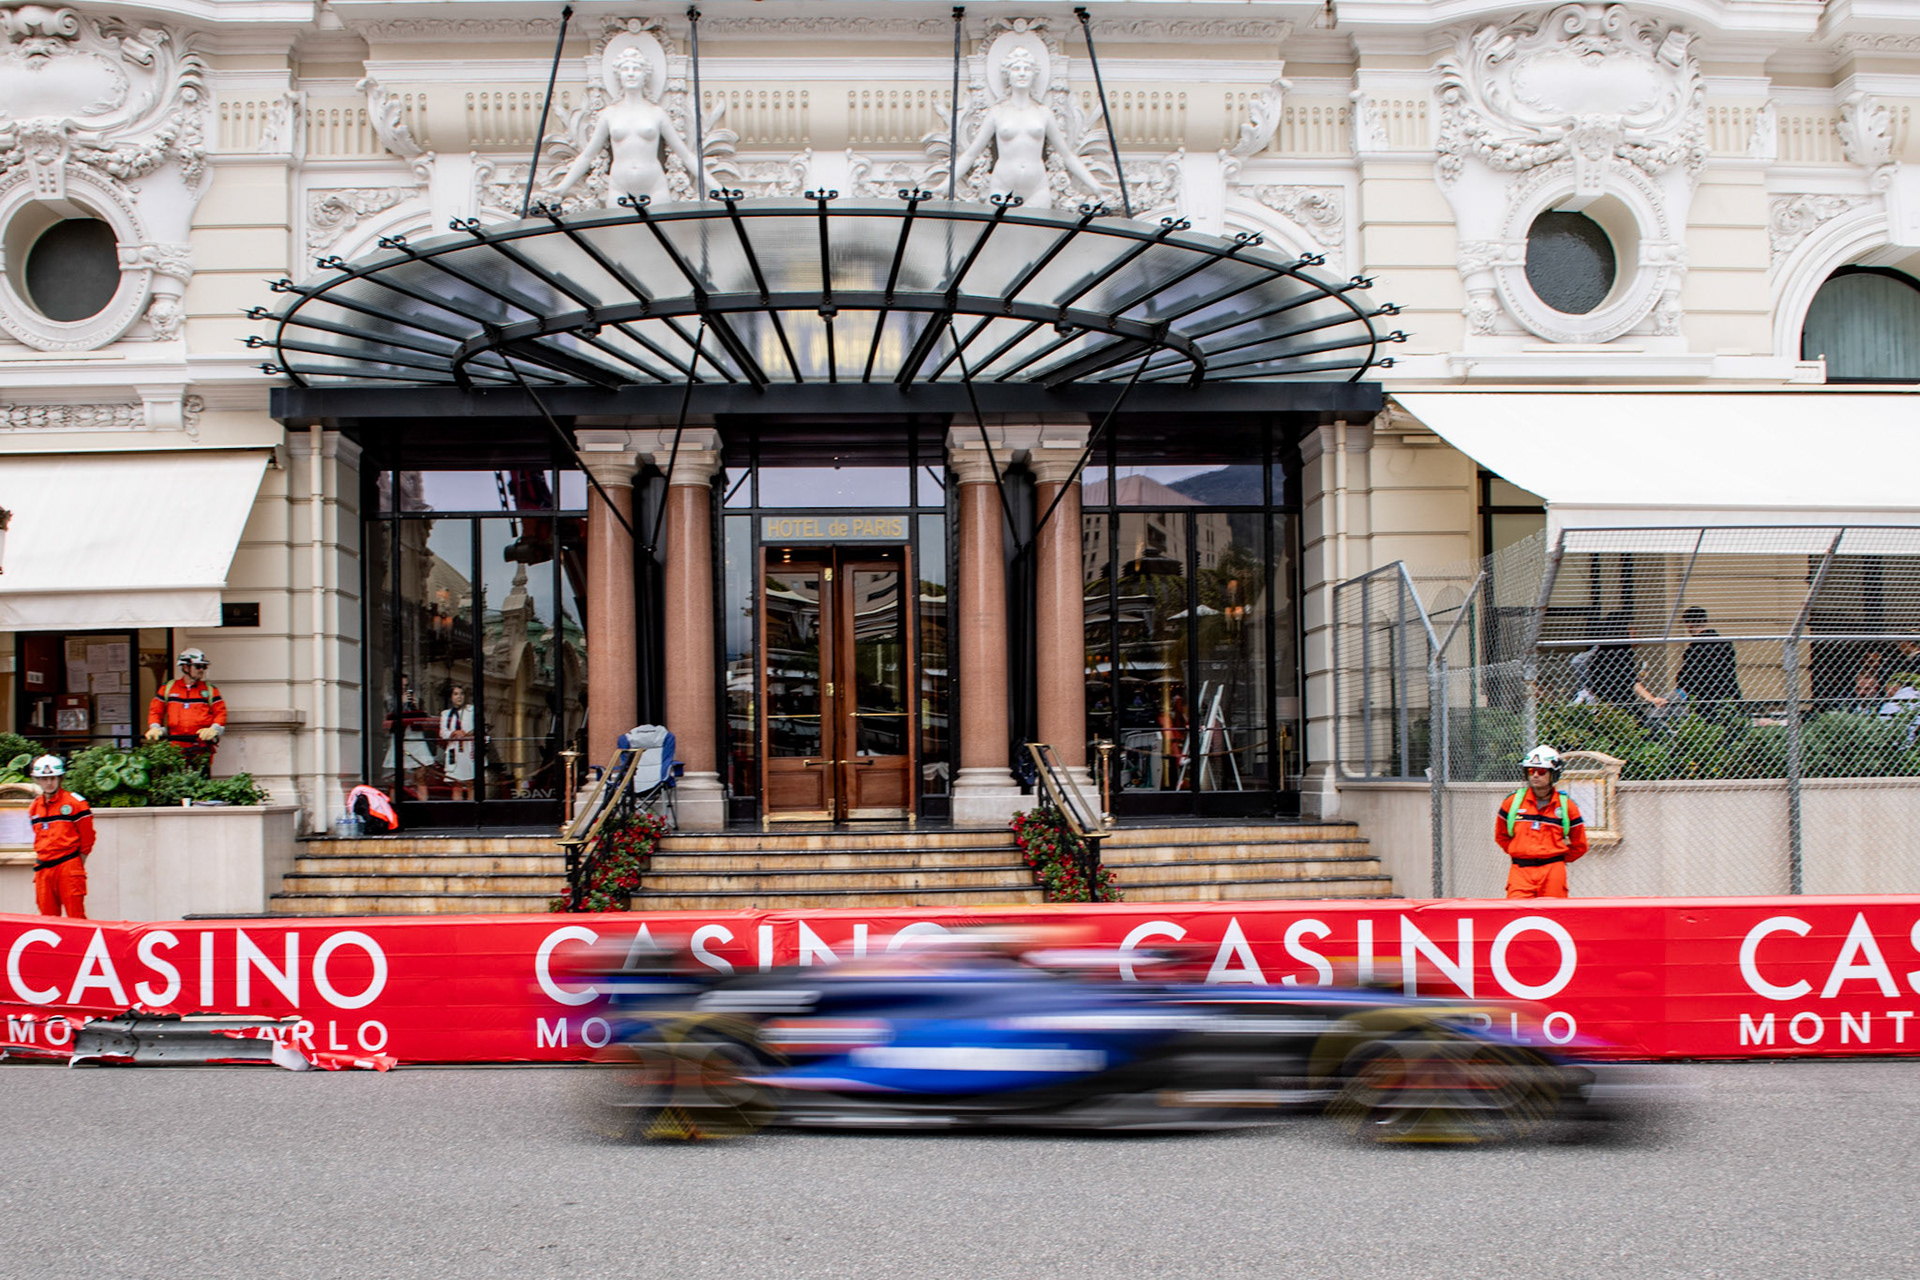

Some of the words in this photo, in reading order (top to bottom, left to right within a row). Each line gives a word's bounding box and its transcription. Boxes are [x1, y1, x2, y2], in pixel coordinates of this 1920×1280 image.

[767, 519, 824, 538] HOTEL
[828, 519, 848, 537] de
[853, 518, 902, 537] PARIS
[7, 927, 389, 1010] CASINO
[1739, 1010, 1915, 1046] MONT
